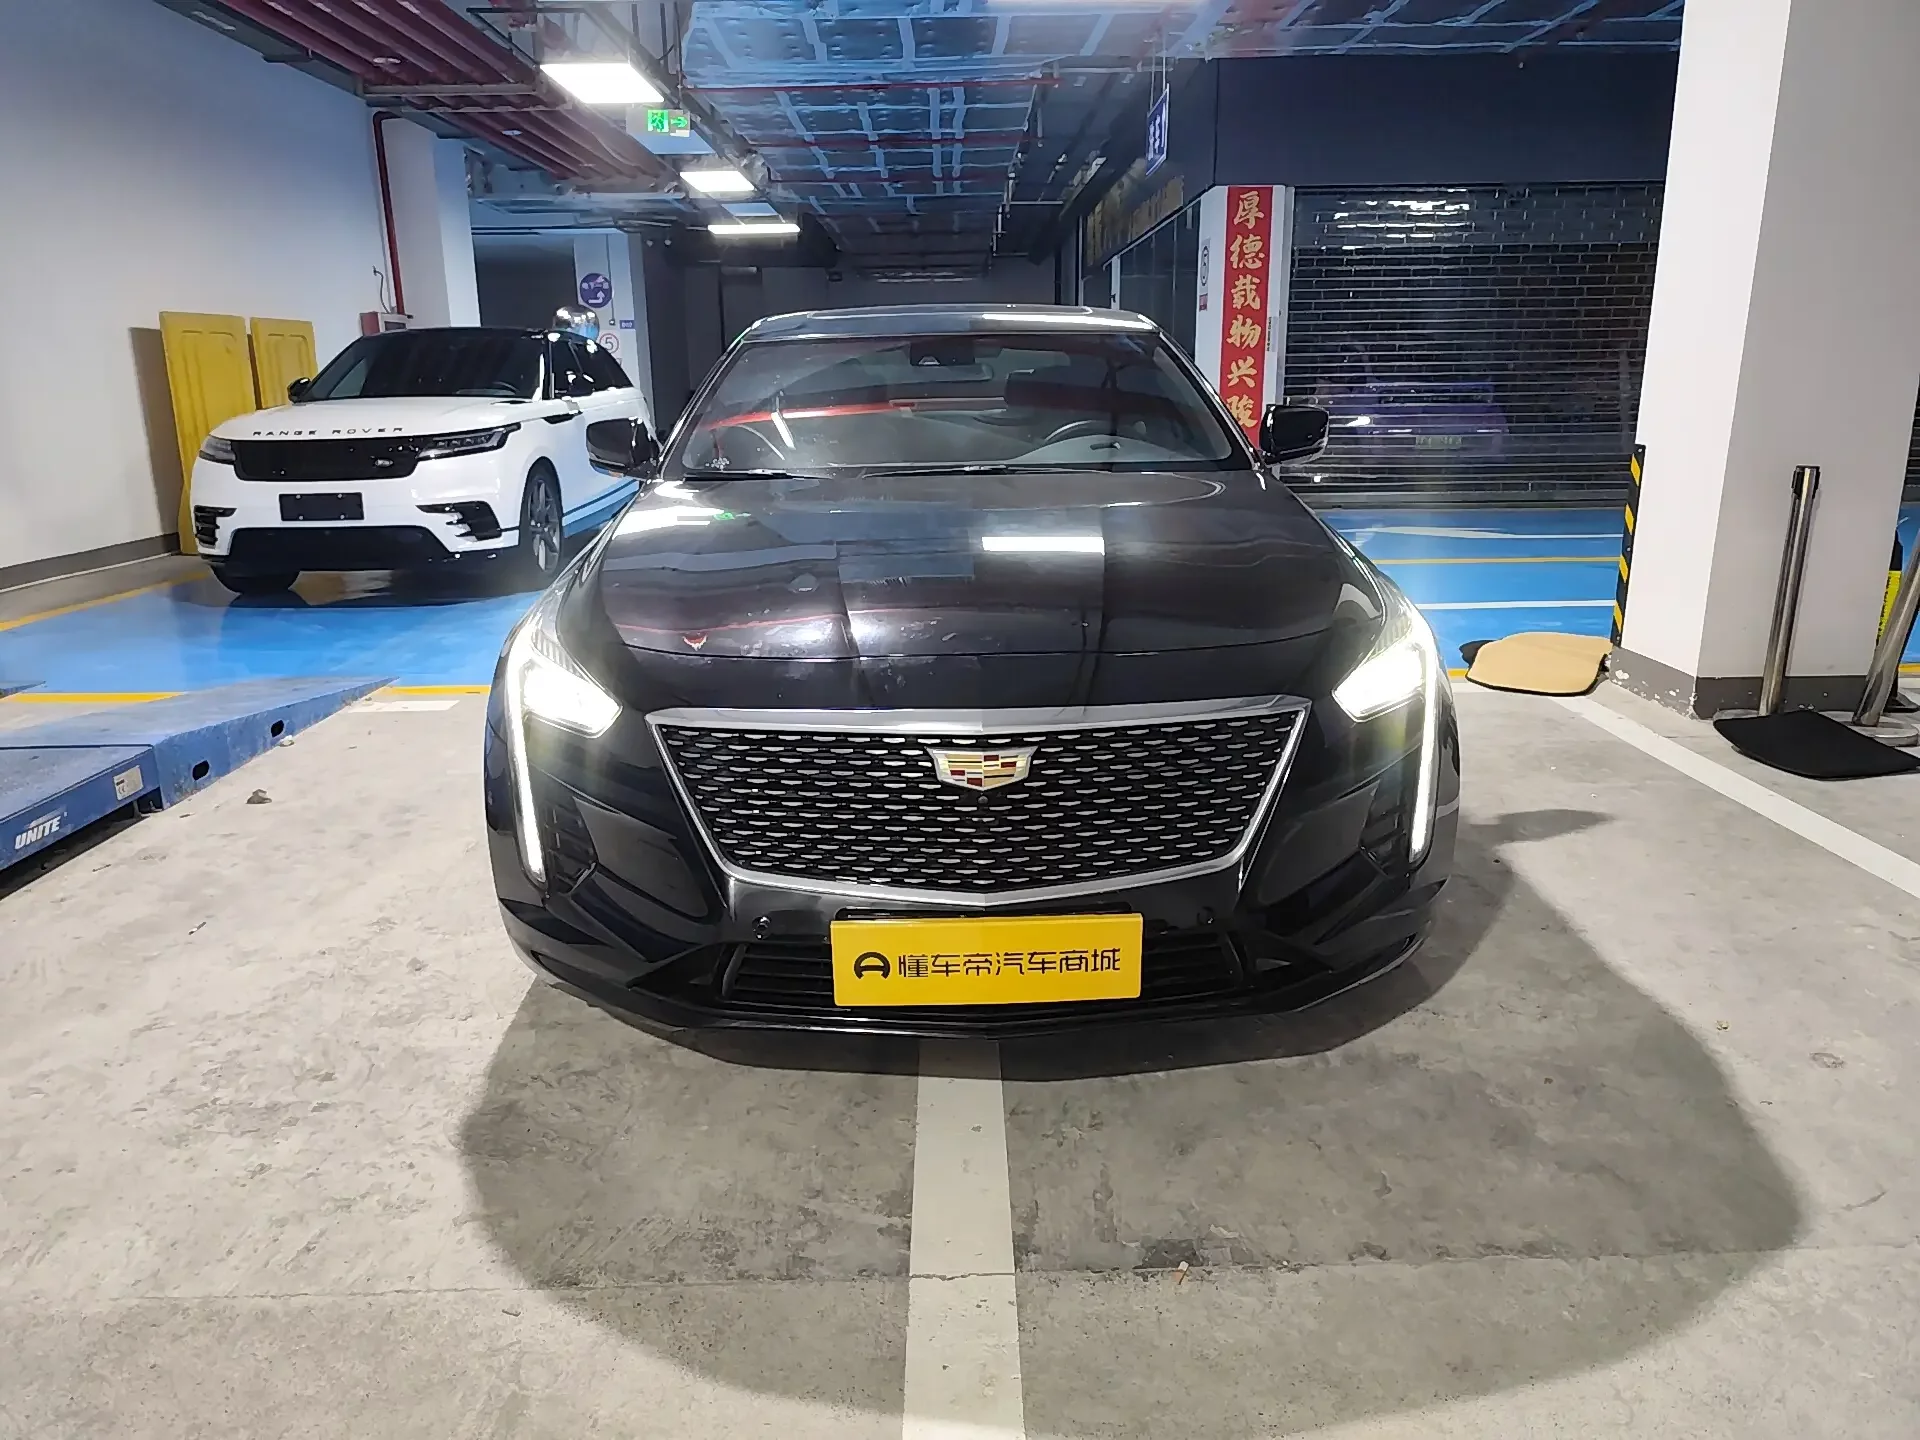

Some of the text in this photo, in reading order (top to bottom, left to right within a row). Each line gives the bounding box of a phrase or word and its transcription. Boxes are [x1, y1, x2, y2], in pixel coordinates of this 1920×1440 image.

[604, 337, 614, 351] 5
[332, 427, 403, 435] ROVER
[14, 815, 62, 850] UNITE
[898, 947, 1122, 978] 懂车帝汽车商城
